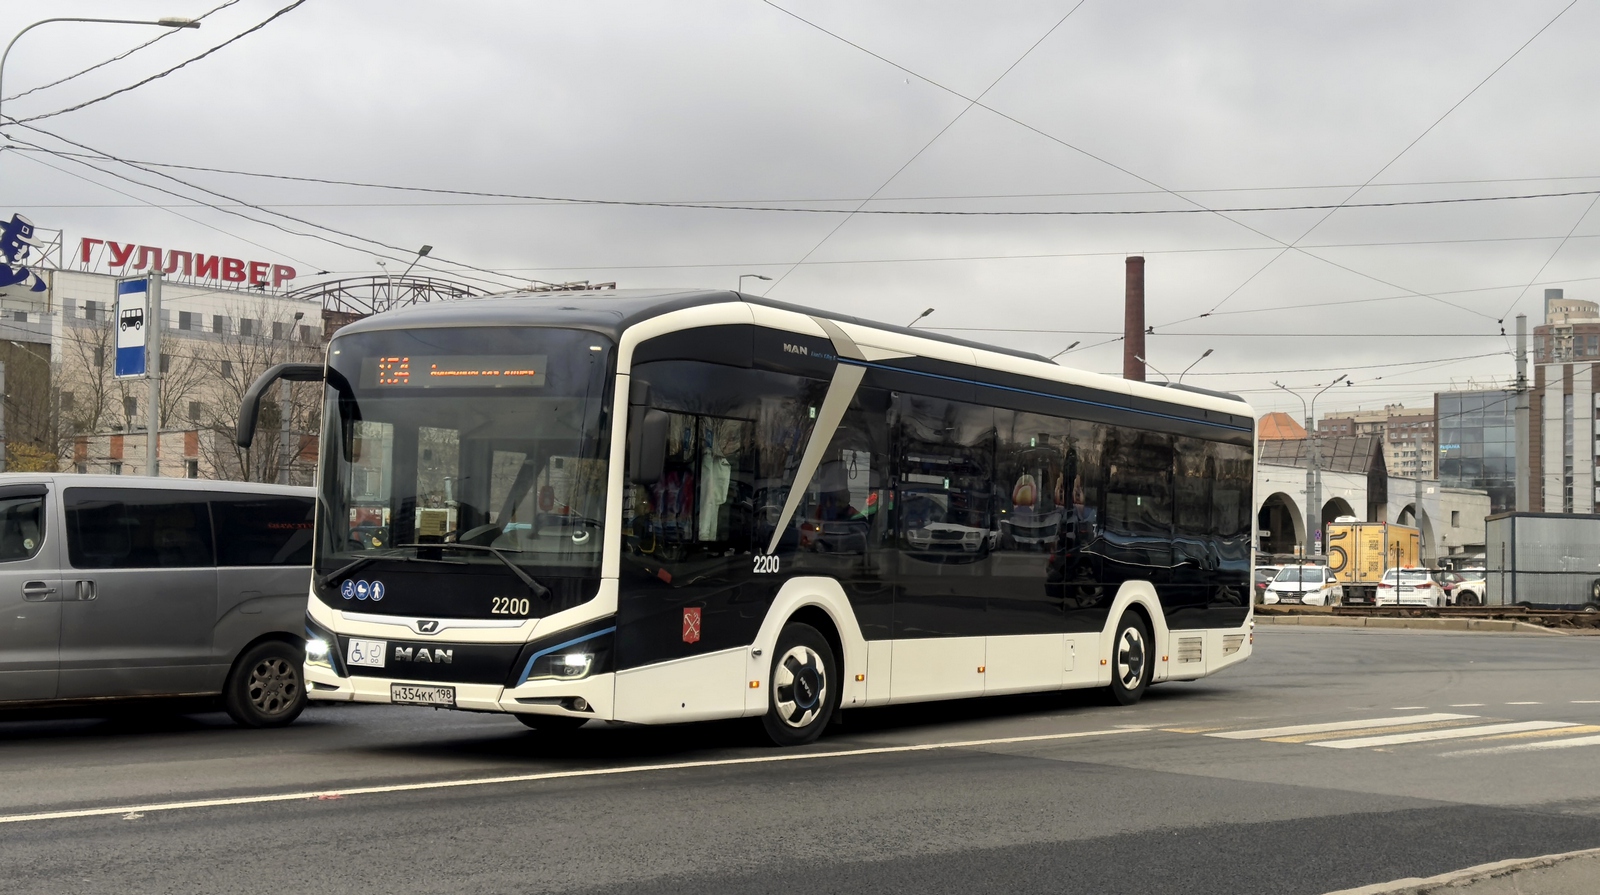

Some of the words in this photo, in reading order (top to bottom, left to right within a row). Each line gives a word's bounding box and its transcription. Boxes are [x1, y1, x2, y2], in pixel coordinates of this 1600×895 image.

[81, 237, 297, 287] ГУЛЛИВЕР
[783, 343, 808, 355] MAN
[753, 555, 780, 573] 2200
[491, 597, 530, 616] 2200
[395, 646, 453, 664] MAN
[436, 689, 452, 699] 198
[800, 676, 812, 697] MAN
